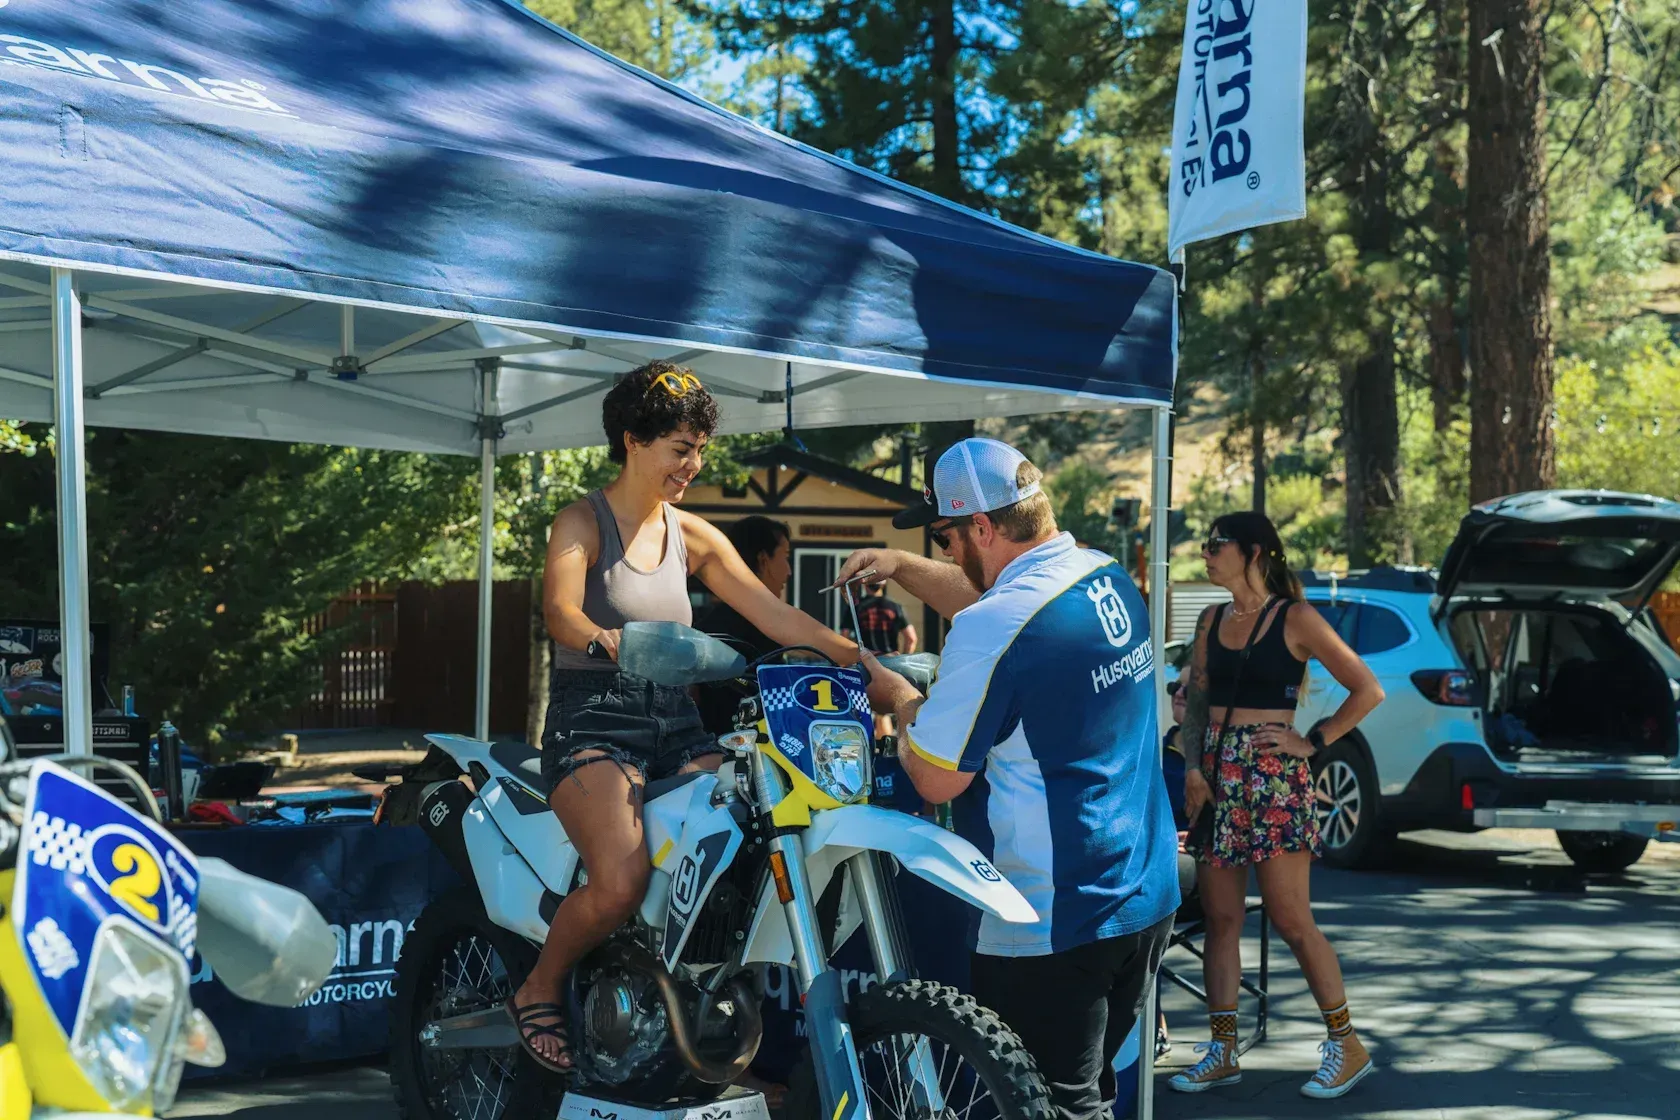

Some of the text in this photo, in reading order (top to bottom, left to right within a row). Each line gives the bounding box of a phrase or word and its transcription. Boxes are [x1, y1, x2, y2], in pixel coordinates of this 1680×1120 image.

[810, 680, 839, 711] 1
[779, 741, 800, 757] DIRT
[108, 843, 161, 922] 2
